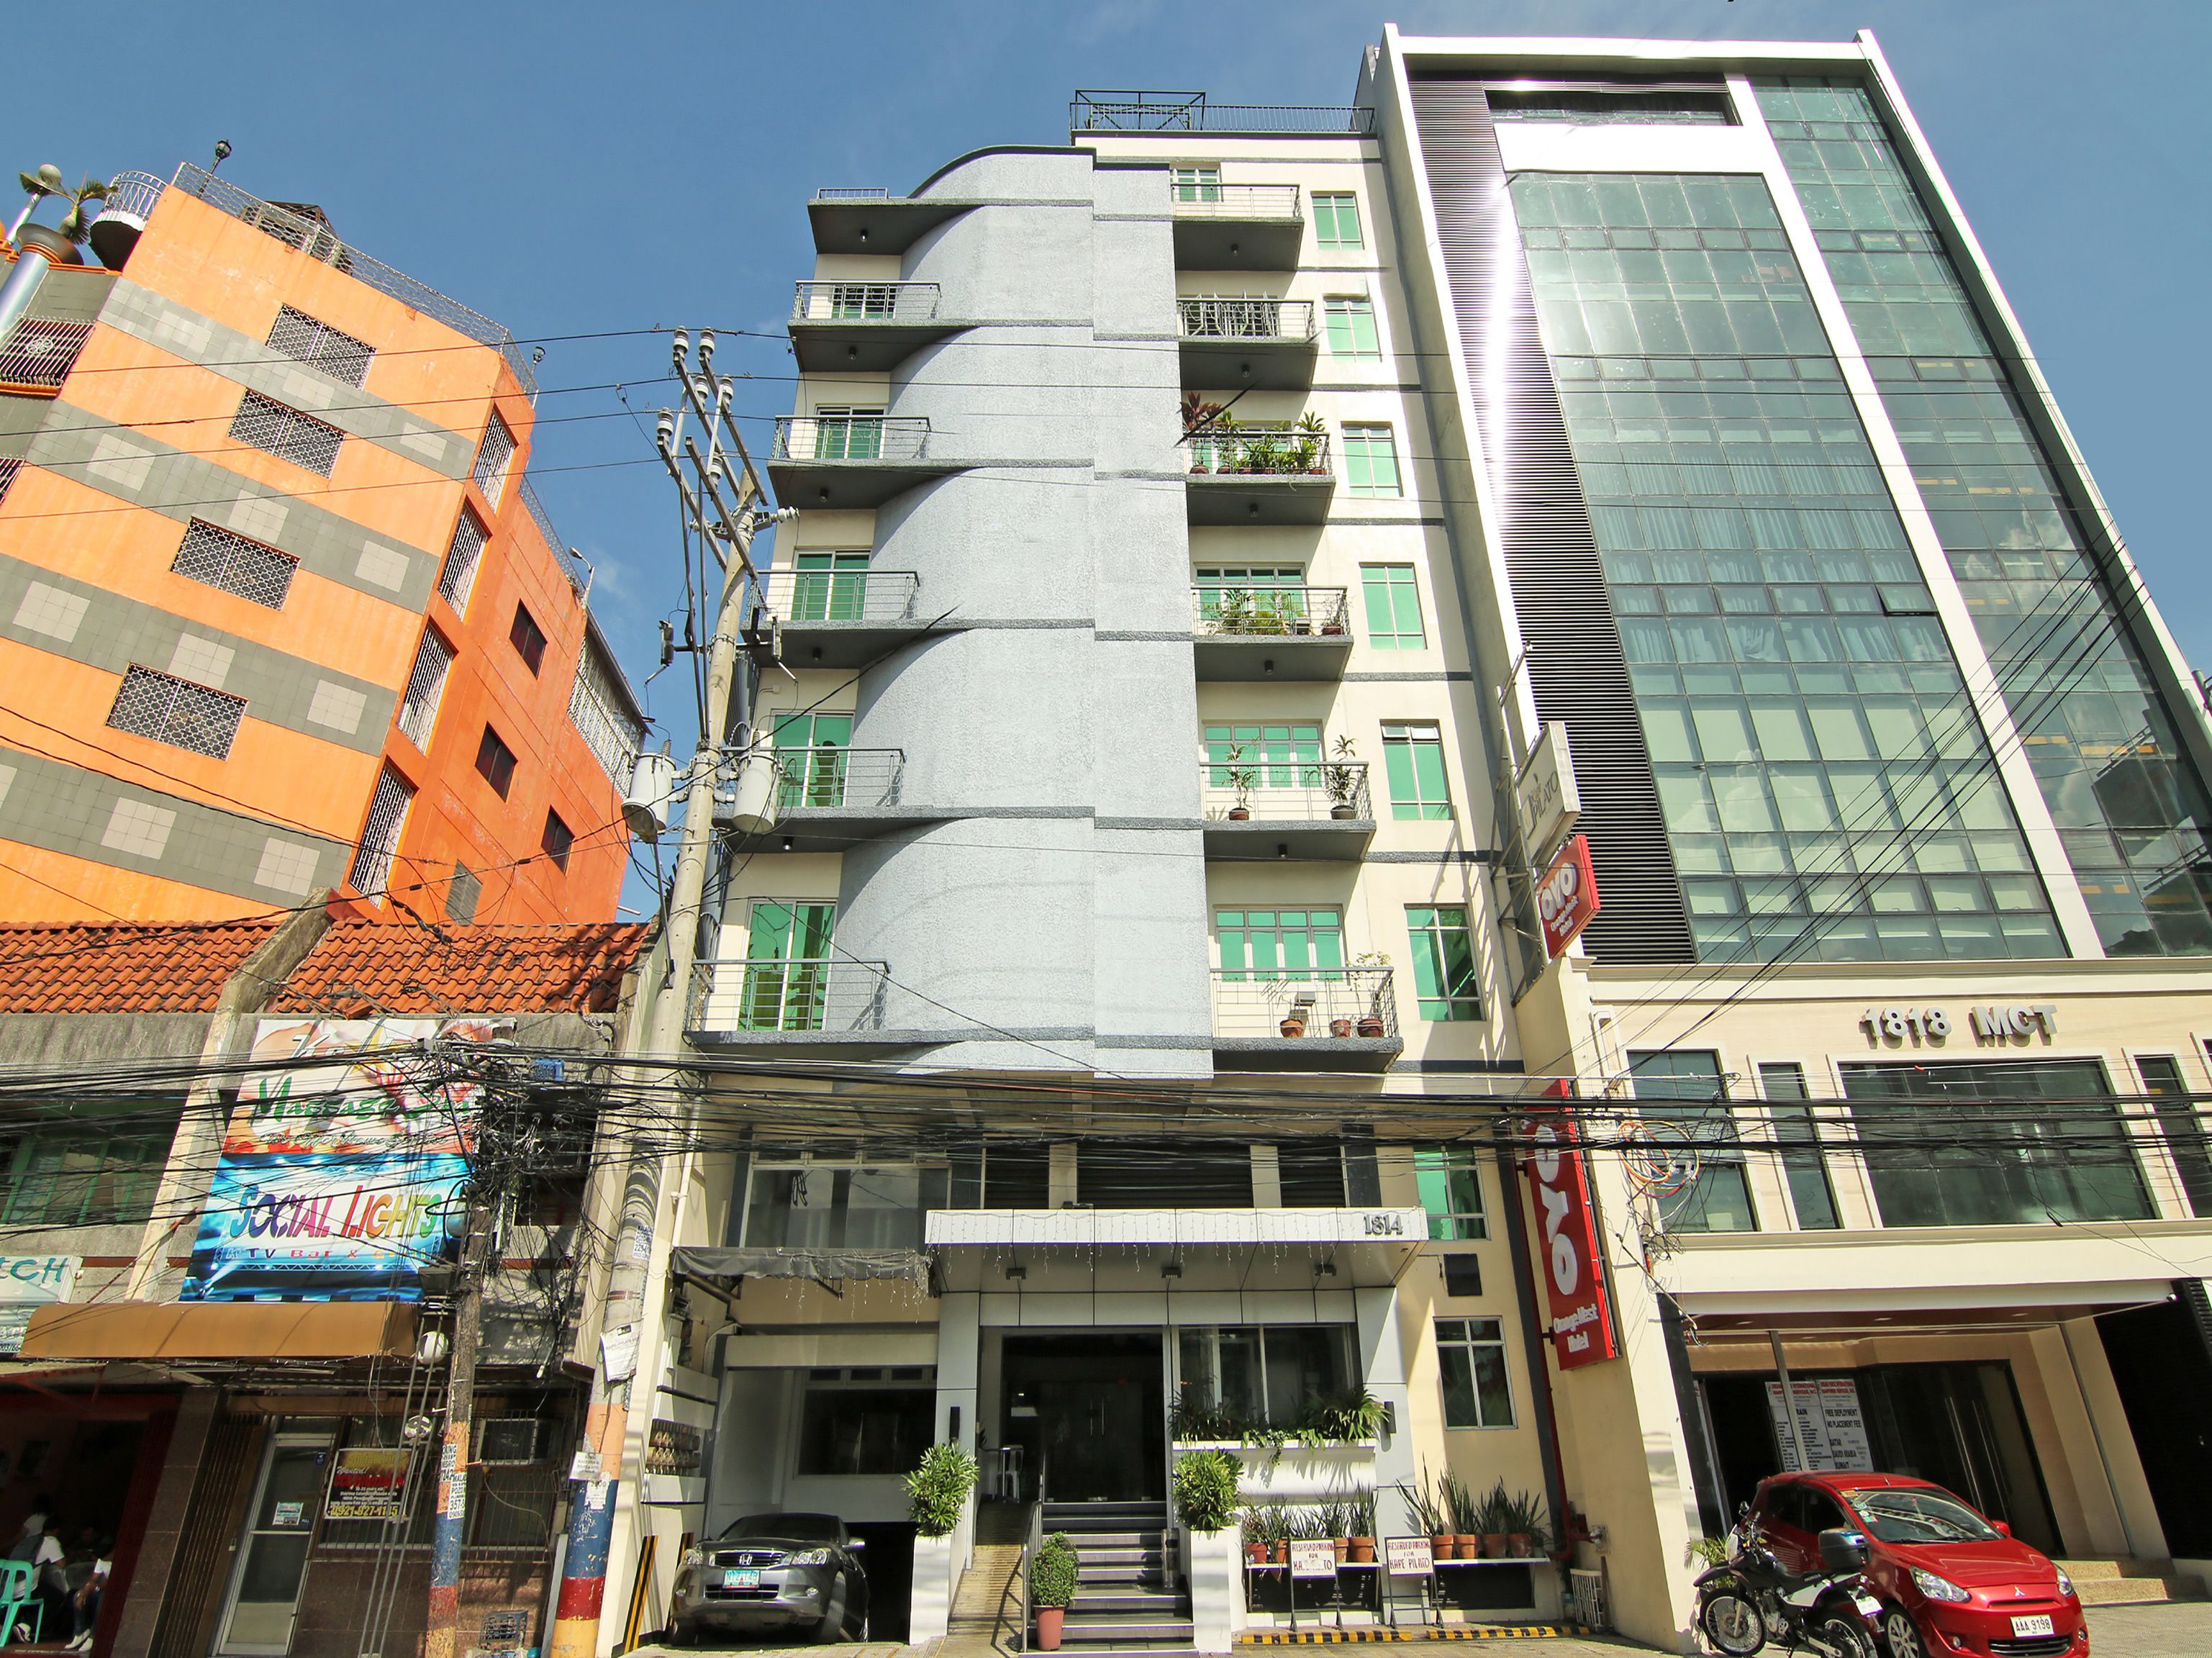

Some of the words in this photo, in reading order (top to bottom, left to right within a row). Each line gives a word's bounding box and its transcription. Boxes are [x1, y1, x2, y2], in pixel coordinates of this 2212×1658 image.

[1541, 862, 1577, 921] OYO
[1861, 1006, 1952, 1040] 1818
[1970, 1005, 2058, 1040] MCT
[258, 1077, 400, 1122] Massage
[230, 1184, 334, 1238] SOCIAL
[340, 1185, 443, 1238] LIGHTS
[1534, 1124, 1577, 1295] OYO
[1364, 1214, 1403, 1236] 1814
[226, 1247, 278, 1259] KTV
[290, 1248, 334, 1259] Bar
[345, 1247, 358, 1259] &
[1567, 1331, 1590, 1353] Hotel
[1292, 1543, 1316, 1552] RESERVED
[1387, 1541, 1412, 1550] RESERVED
[1389, 1559, 1405, 1569] KAPE
[1408, 1557, 1430, 1569] PILATO
[2015, 1621, 2031, 1631] AAA
[2031, 1618, 2051, 1631] 9198
